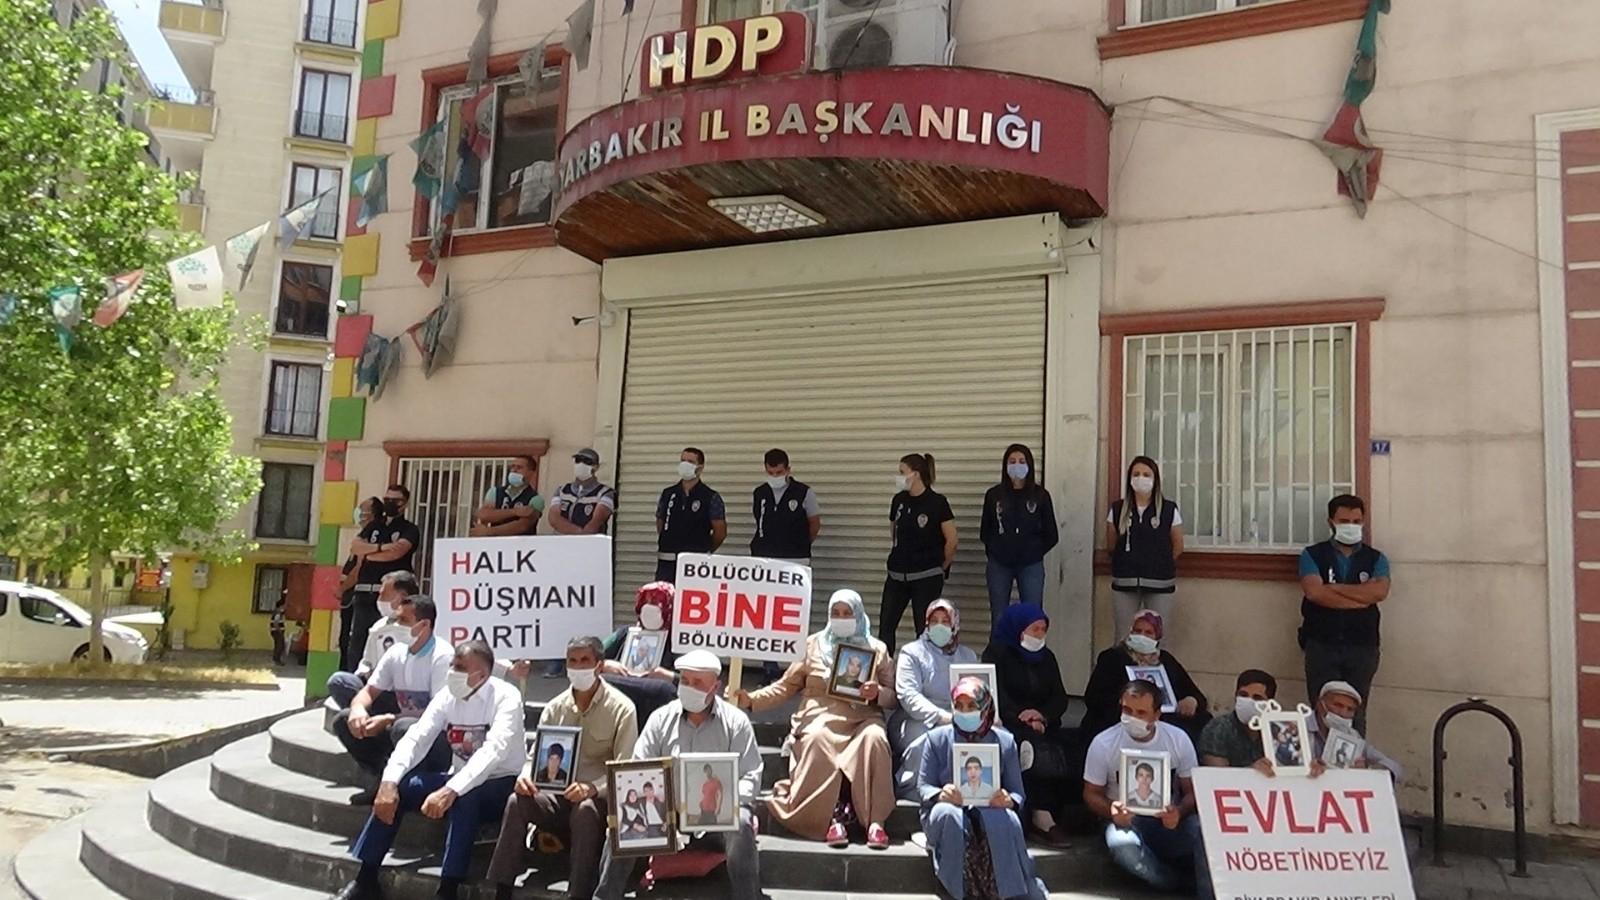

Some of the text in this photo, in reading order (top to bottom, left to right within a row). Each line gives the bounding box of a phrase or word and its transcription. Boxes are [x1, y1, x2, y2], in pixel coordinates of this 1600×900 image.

[649, 15, 783, 88] HDP
[746, 100, 1042, 153] BAŞKANLIĞI
[452, 550, 537, 575] HALK
[683, 561, 804, 586] BÖLÜCÜLER
[451, 583, 596, 617] DÜŞMANI
[679, 583, 803, 633] BİNE
[451, 619, 541, 649] PARTİ
[678, 630, 798, 655] BÖLÜNECEK
[1213, 790, 1375, 834] EVLAT
[1226, 848, 1389, 871] NÖBETİNDEYİZ
